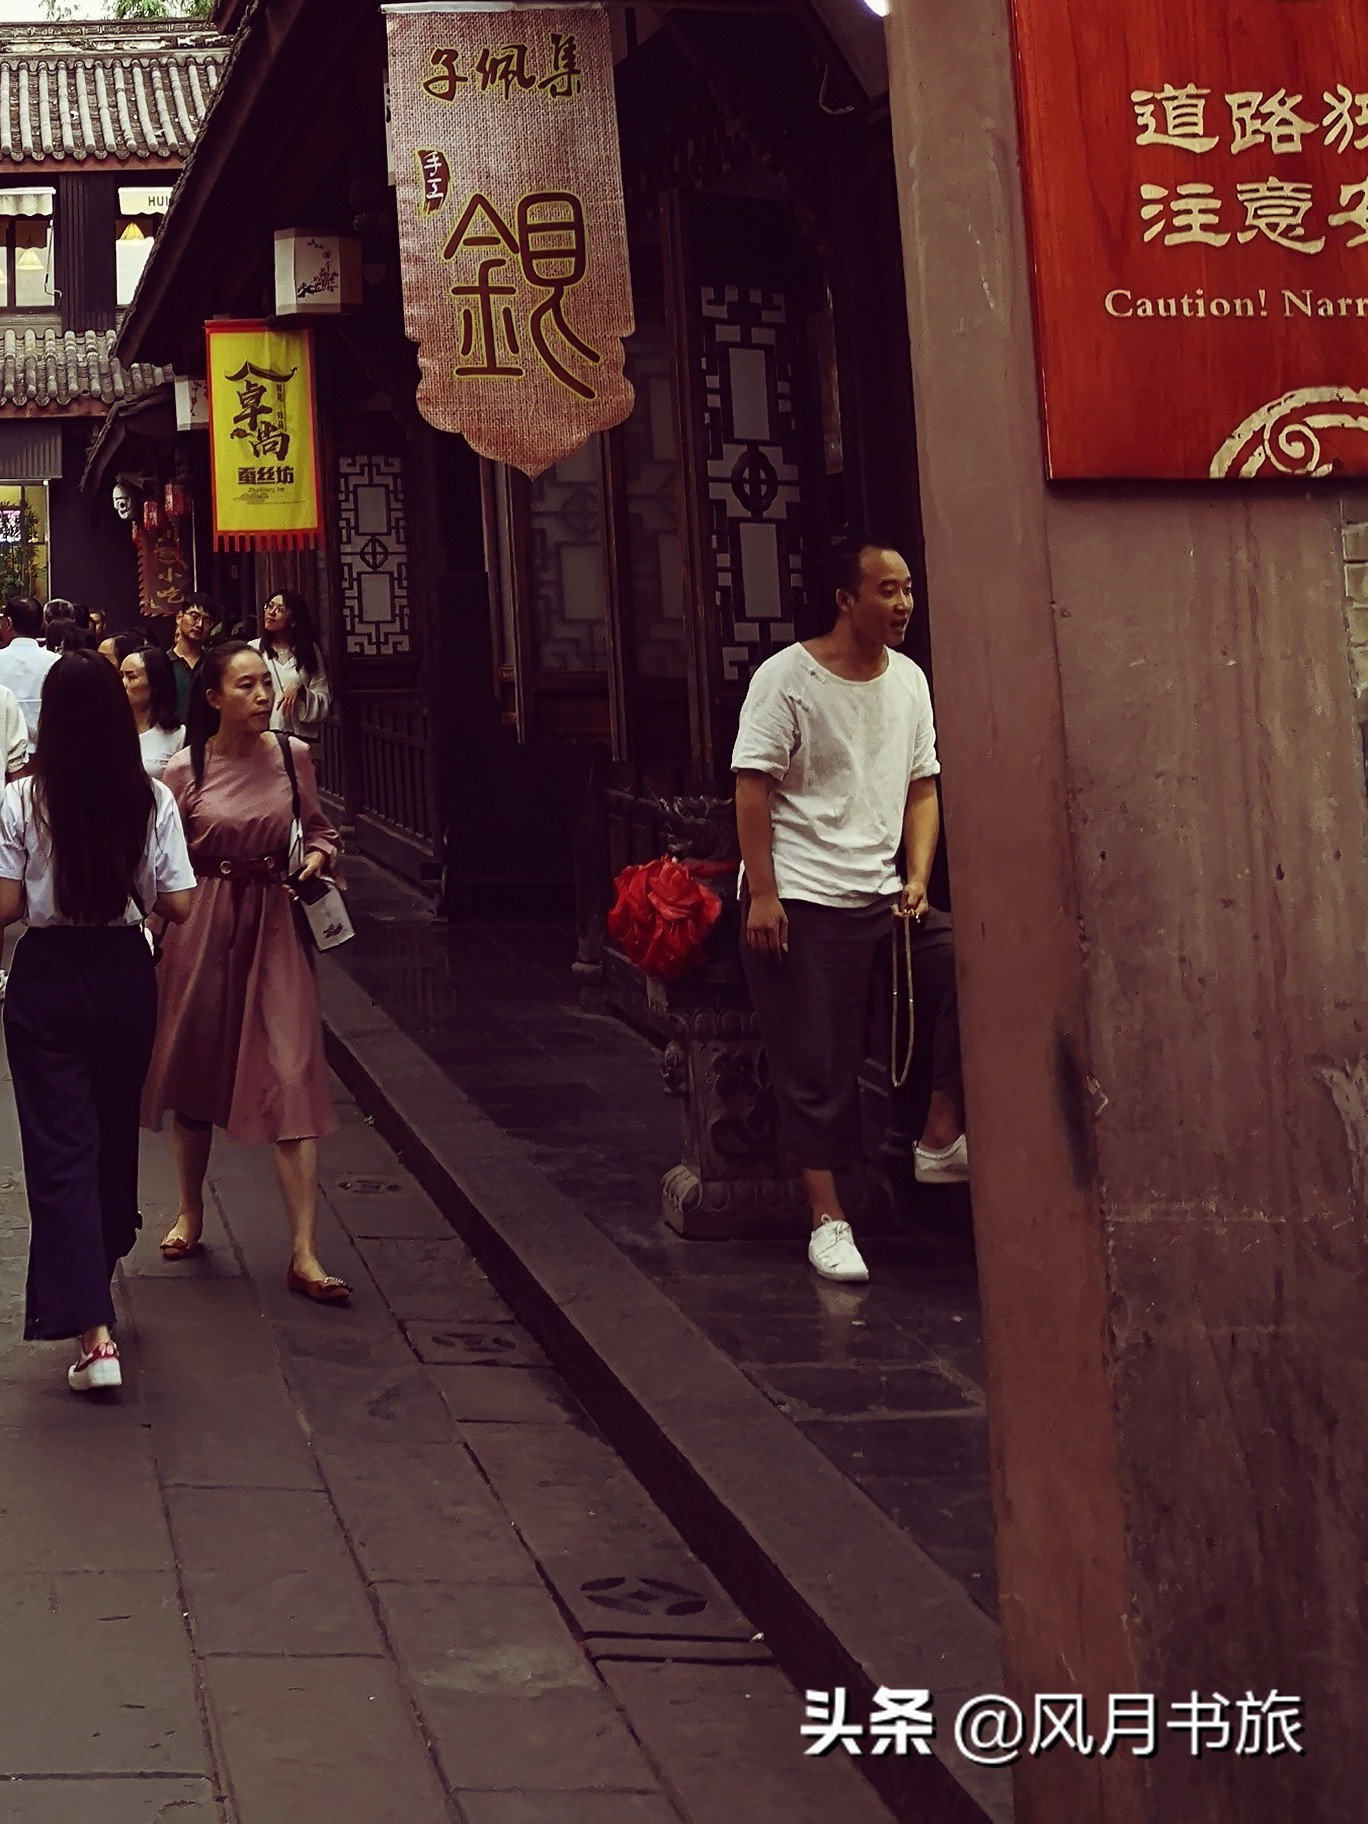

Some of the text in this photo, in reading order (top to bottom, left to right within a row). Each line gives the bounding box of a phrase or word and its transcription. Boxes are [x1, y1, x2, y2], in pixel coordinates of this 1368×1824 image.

[423, 151, 444, 200] 手工
[1105, 288, 1269, 319] Caution!
[237, 466, 295, 485] 蚕丝坊
